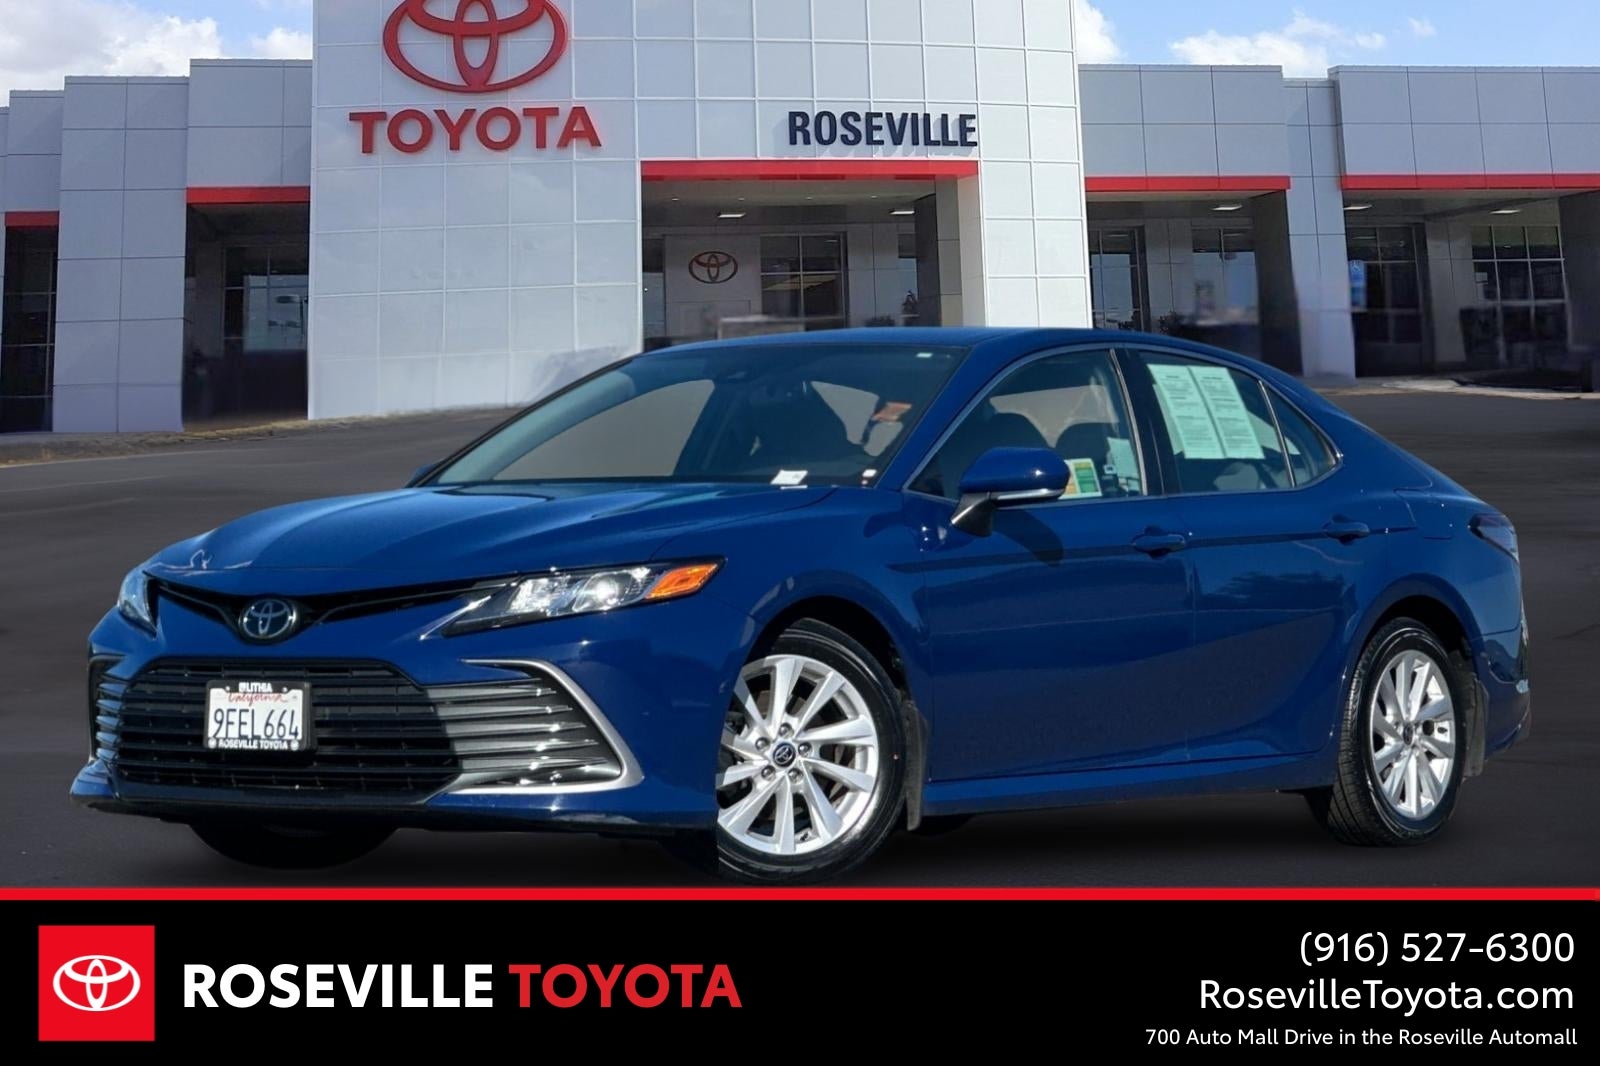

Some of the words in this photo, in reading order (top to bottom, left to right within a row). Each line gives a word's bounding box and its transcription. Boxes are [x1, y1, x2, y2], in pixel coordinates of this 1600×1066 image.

[349, 106, 602, 154] TOYOTA
[788, 110, 978, 147] ROSEVILLE
[246, 682, 273, 693] LITHIA
[213, 708, 299, 739] 9FEL664
[218, 739, 258, 749] ROSEVILLE
[260, 740, 288, 749] TOYOTA
